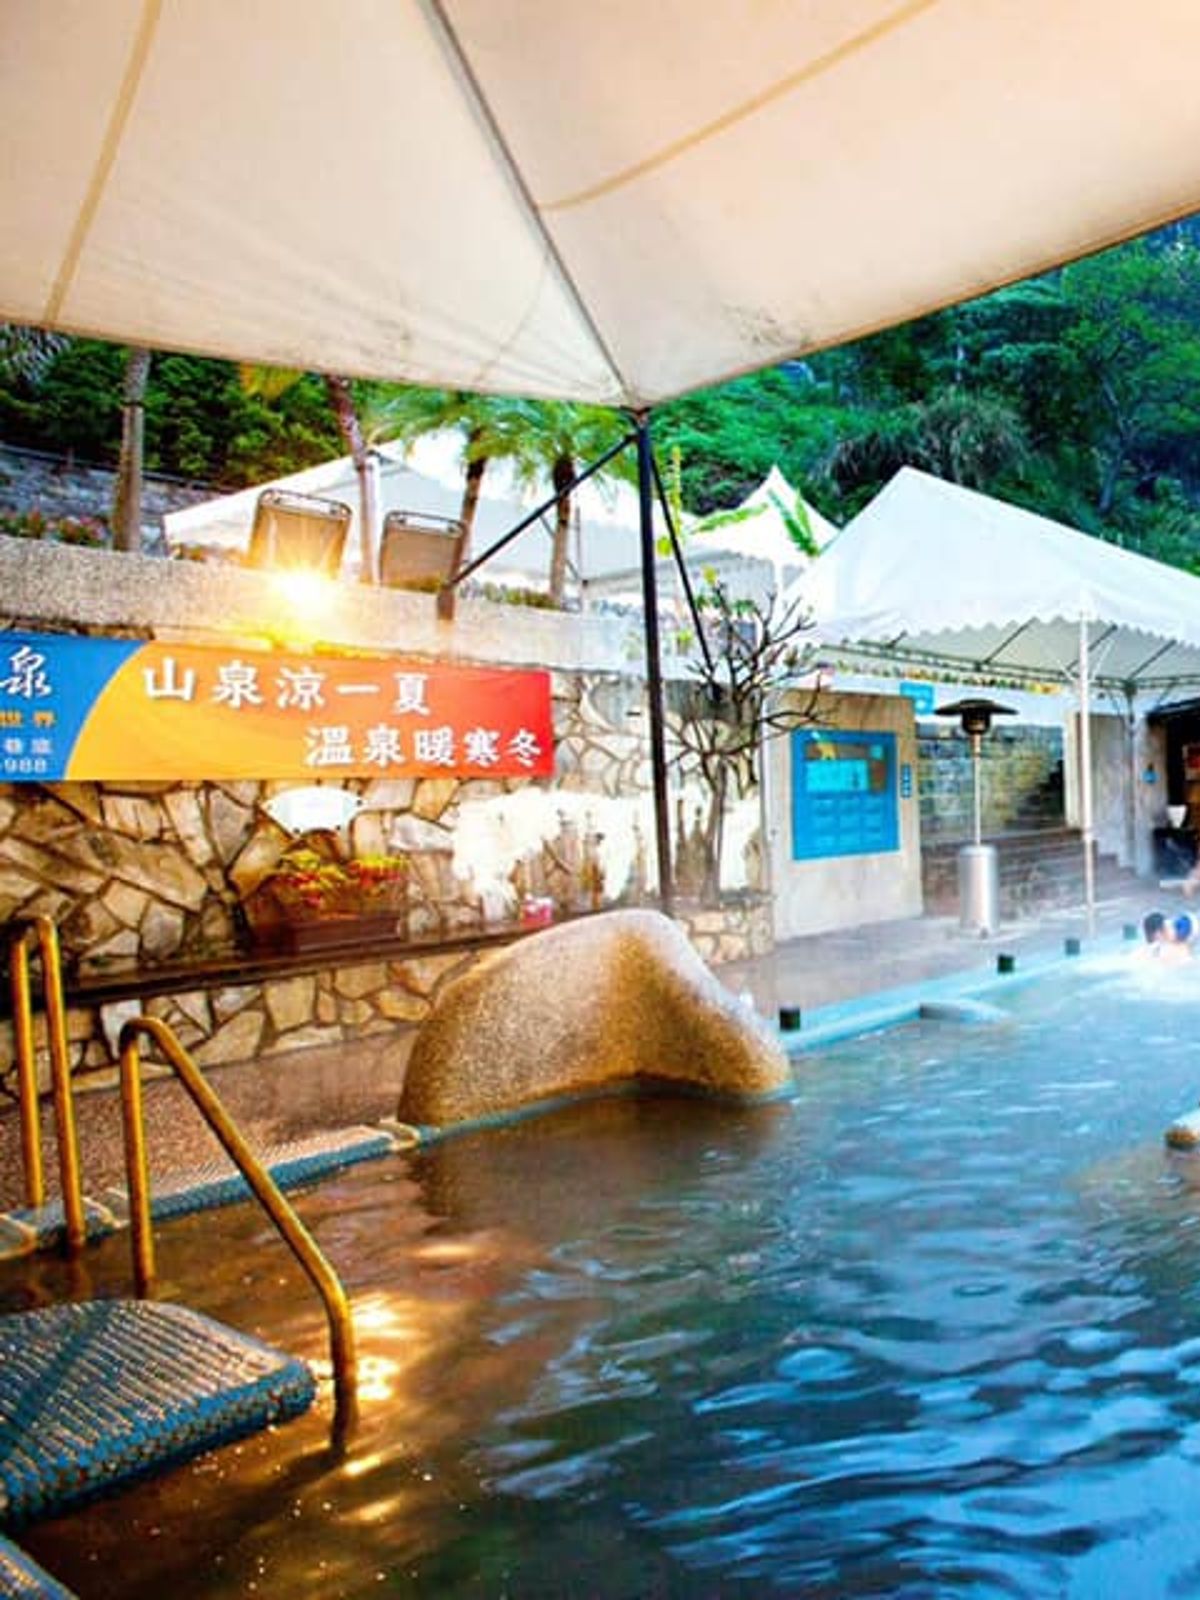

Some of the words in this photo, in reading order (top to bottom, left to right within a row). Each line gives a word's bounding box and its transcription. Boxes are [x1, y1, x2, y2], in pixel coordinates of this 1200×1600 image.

[0, 645, 52, 698] 泉
[142, 656, 430, 716] 山泉涼一夏
